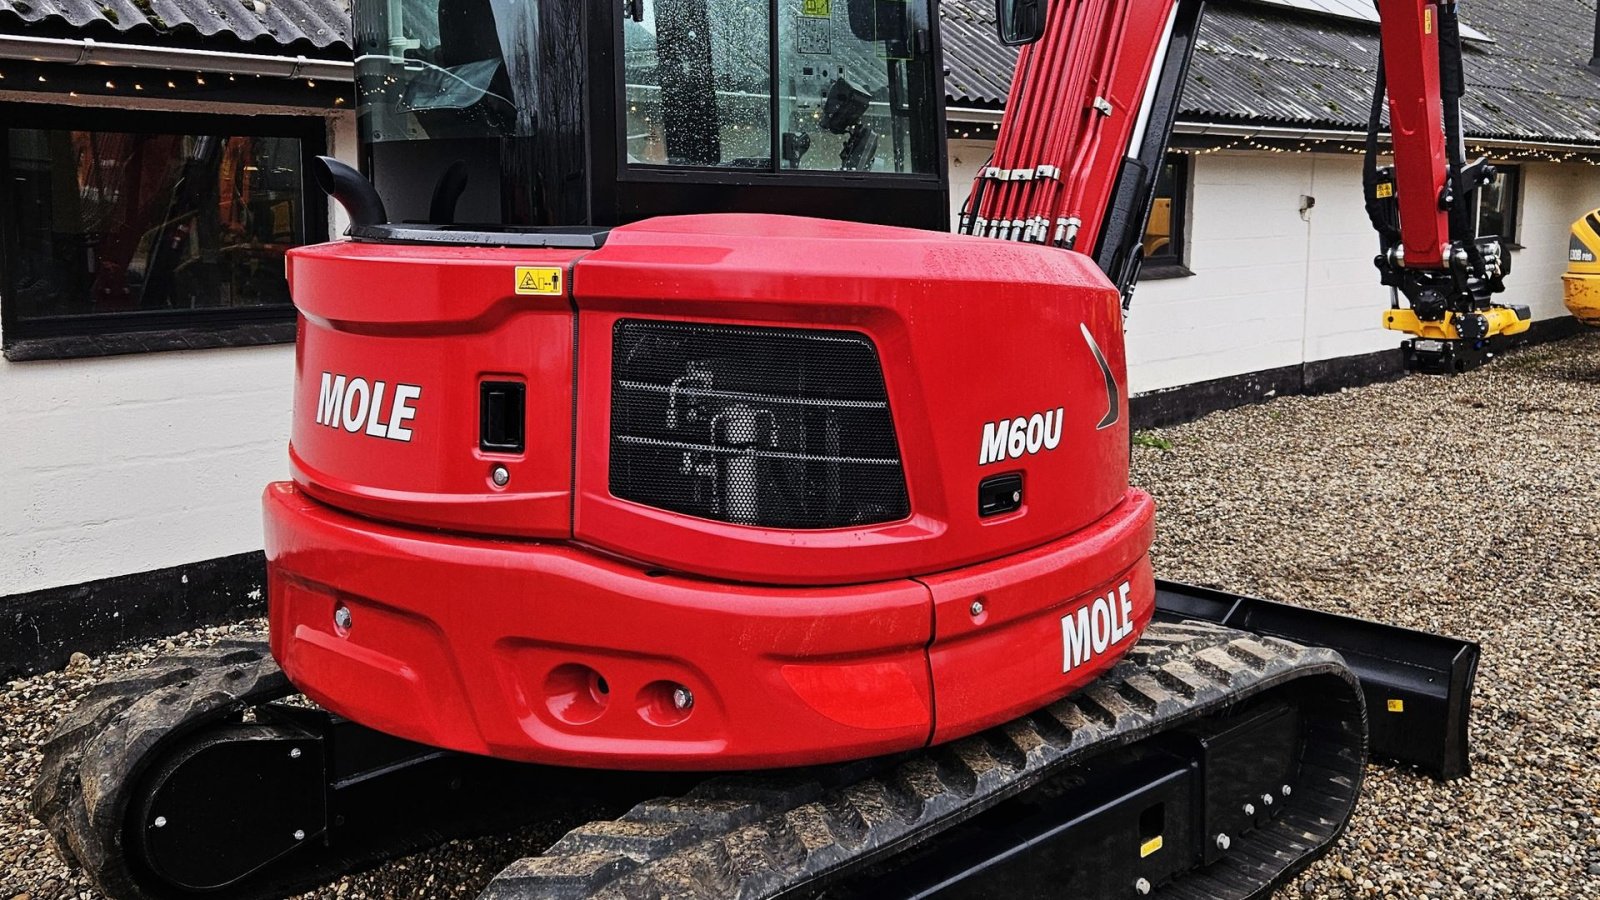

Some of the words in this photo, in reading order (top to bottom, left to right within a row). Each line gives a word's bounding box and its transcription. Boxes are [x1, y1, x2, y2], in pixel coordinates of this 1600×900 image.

[316, 371, 422, 442] MOLE
[979, 407, 1064, 465] M60U
[1061, 579, 1133, 674] MOLE
